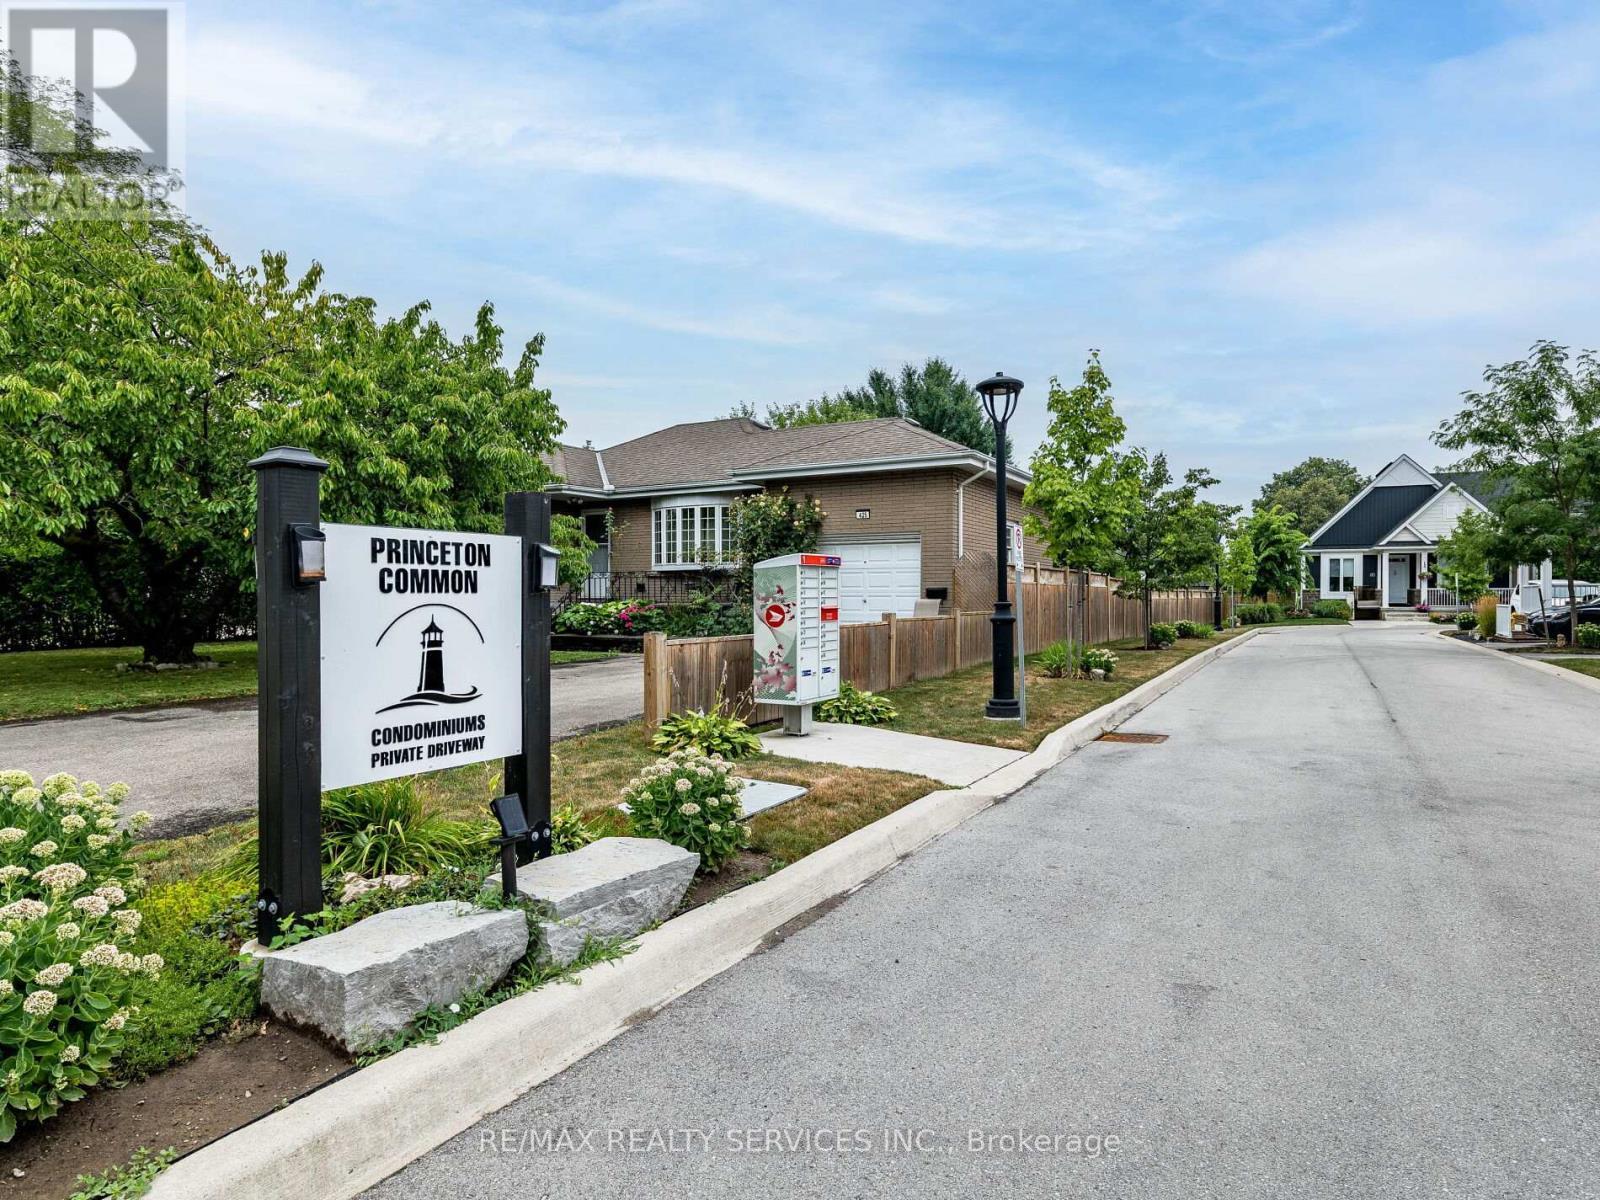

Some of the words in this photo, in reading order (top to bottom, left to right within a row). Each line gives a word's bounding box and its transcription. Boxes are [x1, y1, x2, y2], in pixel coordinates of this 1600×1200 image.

[370, 537, 491, 567] PRINCETON
[379, 567, 478, 594] COMMON
[371, 714, 486, 747] CONDOMINIUMS
[371, 746, 424, 769] PRIVATE
[427, 736, 486, 759] DRIVEWAY
